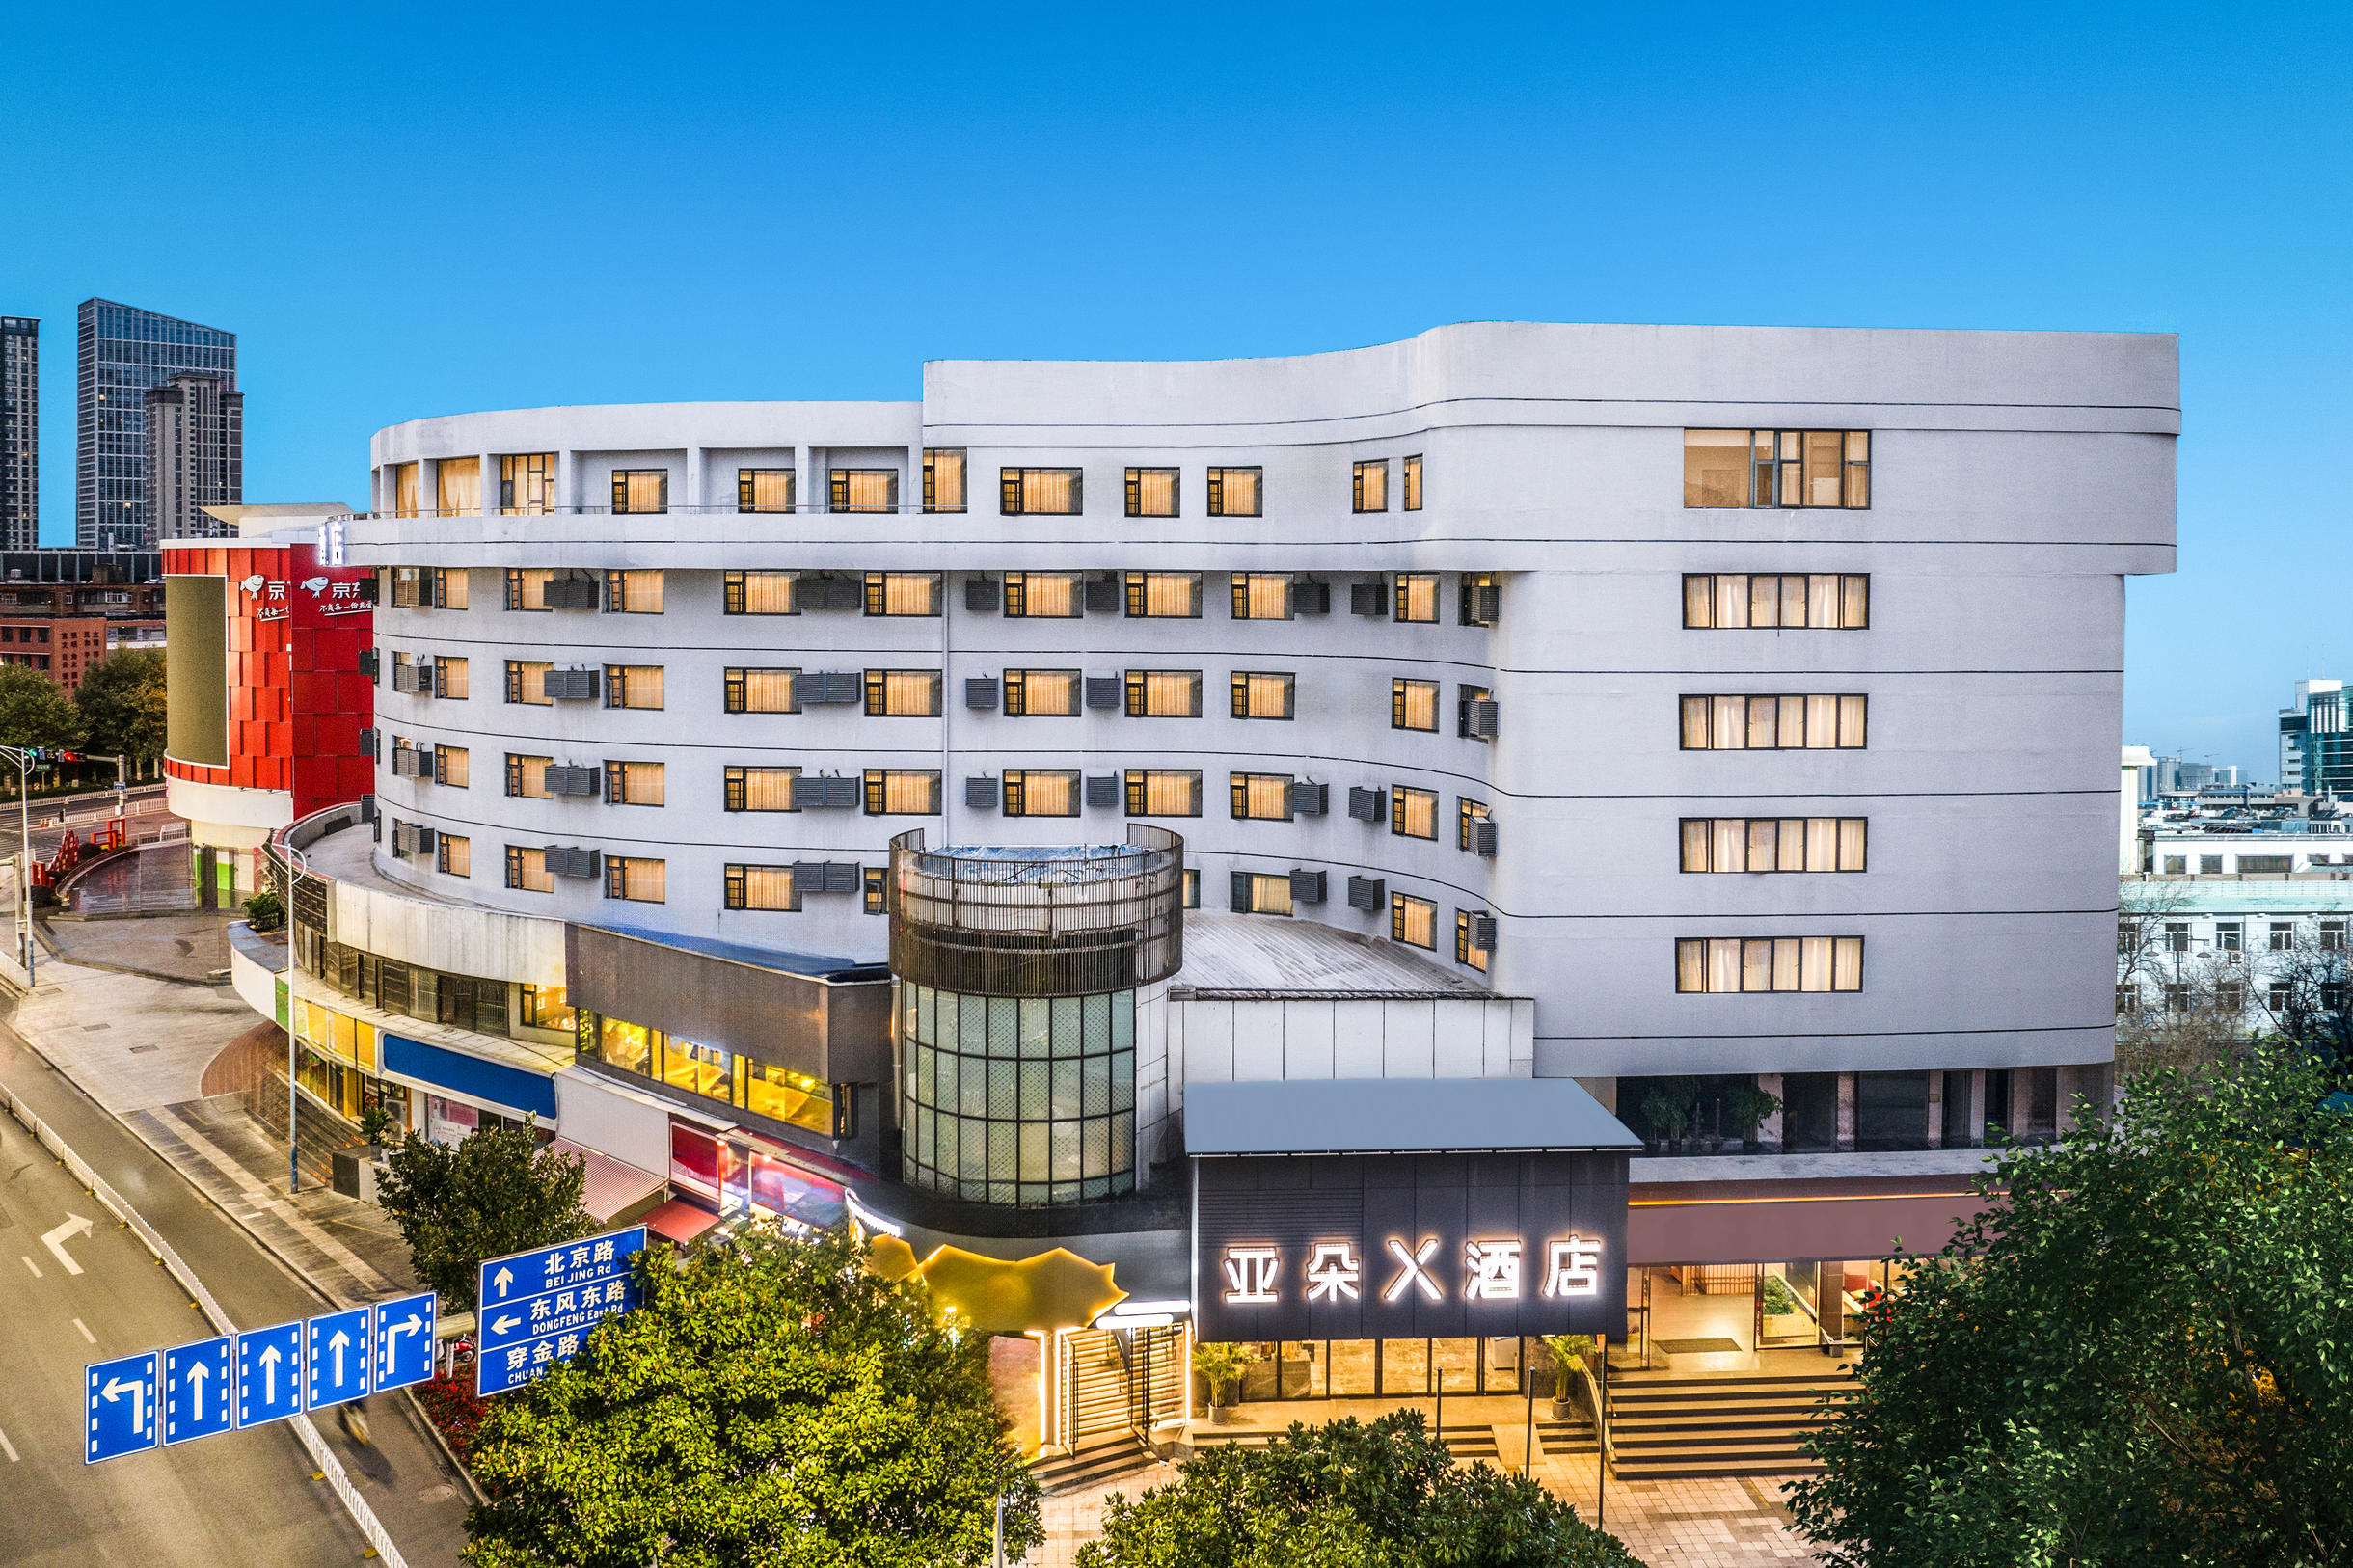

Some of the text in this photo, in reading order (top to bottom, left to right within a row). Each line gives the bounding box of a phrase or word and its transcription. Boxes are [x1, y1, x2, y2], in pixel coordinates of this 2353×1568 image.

[267, 581, 291, 600] 京
[544, 1240, 615, 1275] 北京路
[545, 1264, 611, 1288] BEI JING Rd
[530, 1280, 626, 1321] 东风东路
[532, 1311, 585, 1335] DONGFENG
[610, 1303, 623, 1314] Rd
[506, 1334, 579, 1371] 穿金路
[507, 1365, 544, 1385] CHUAN
